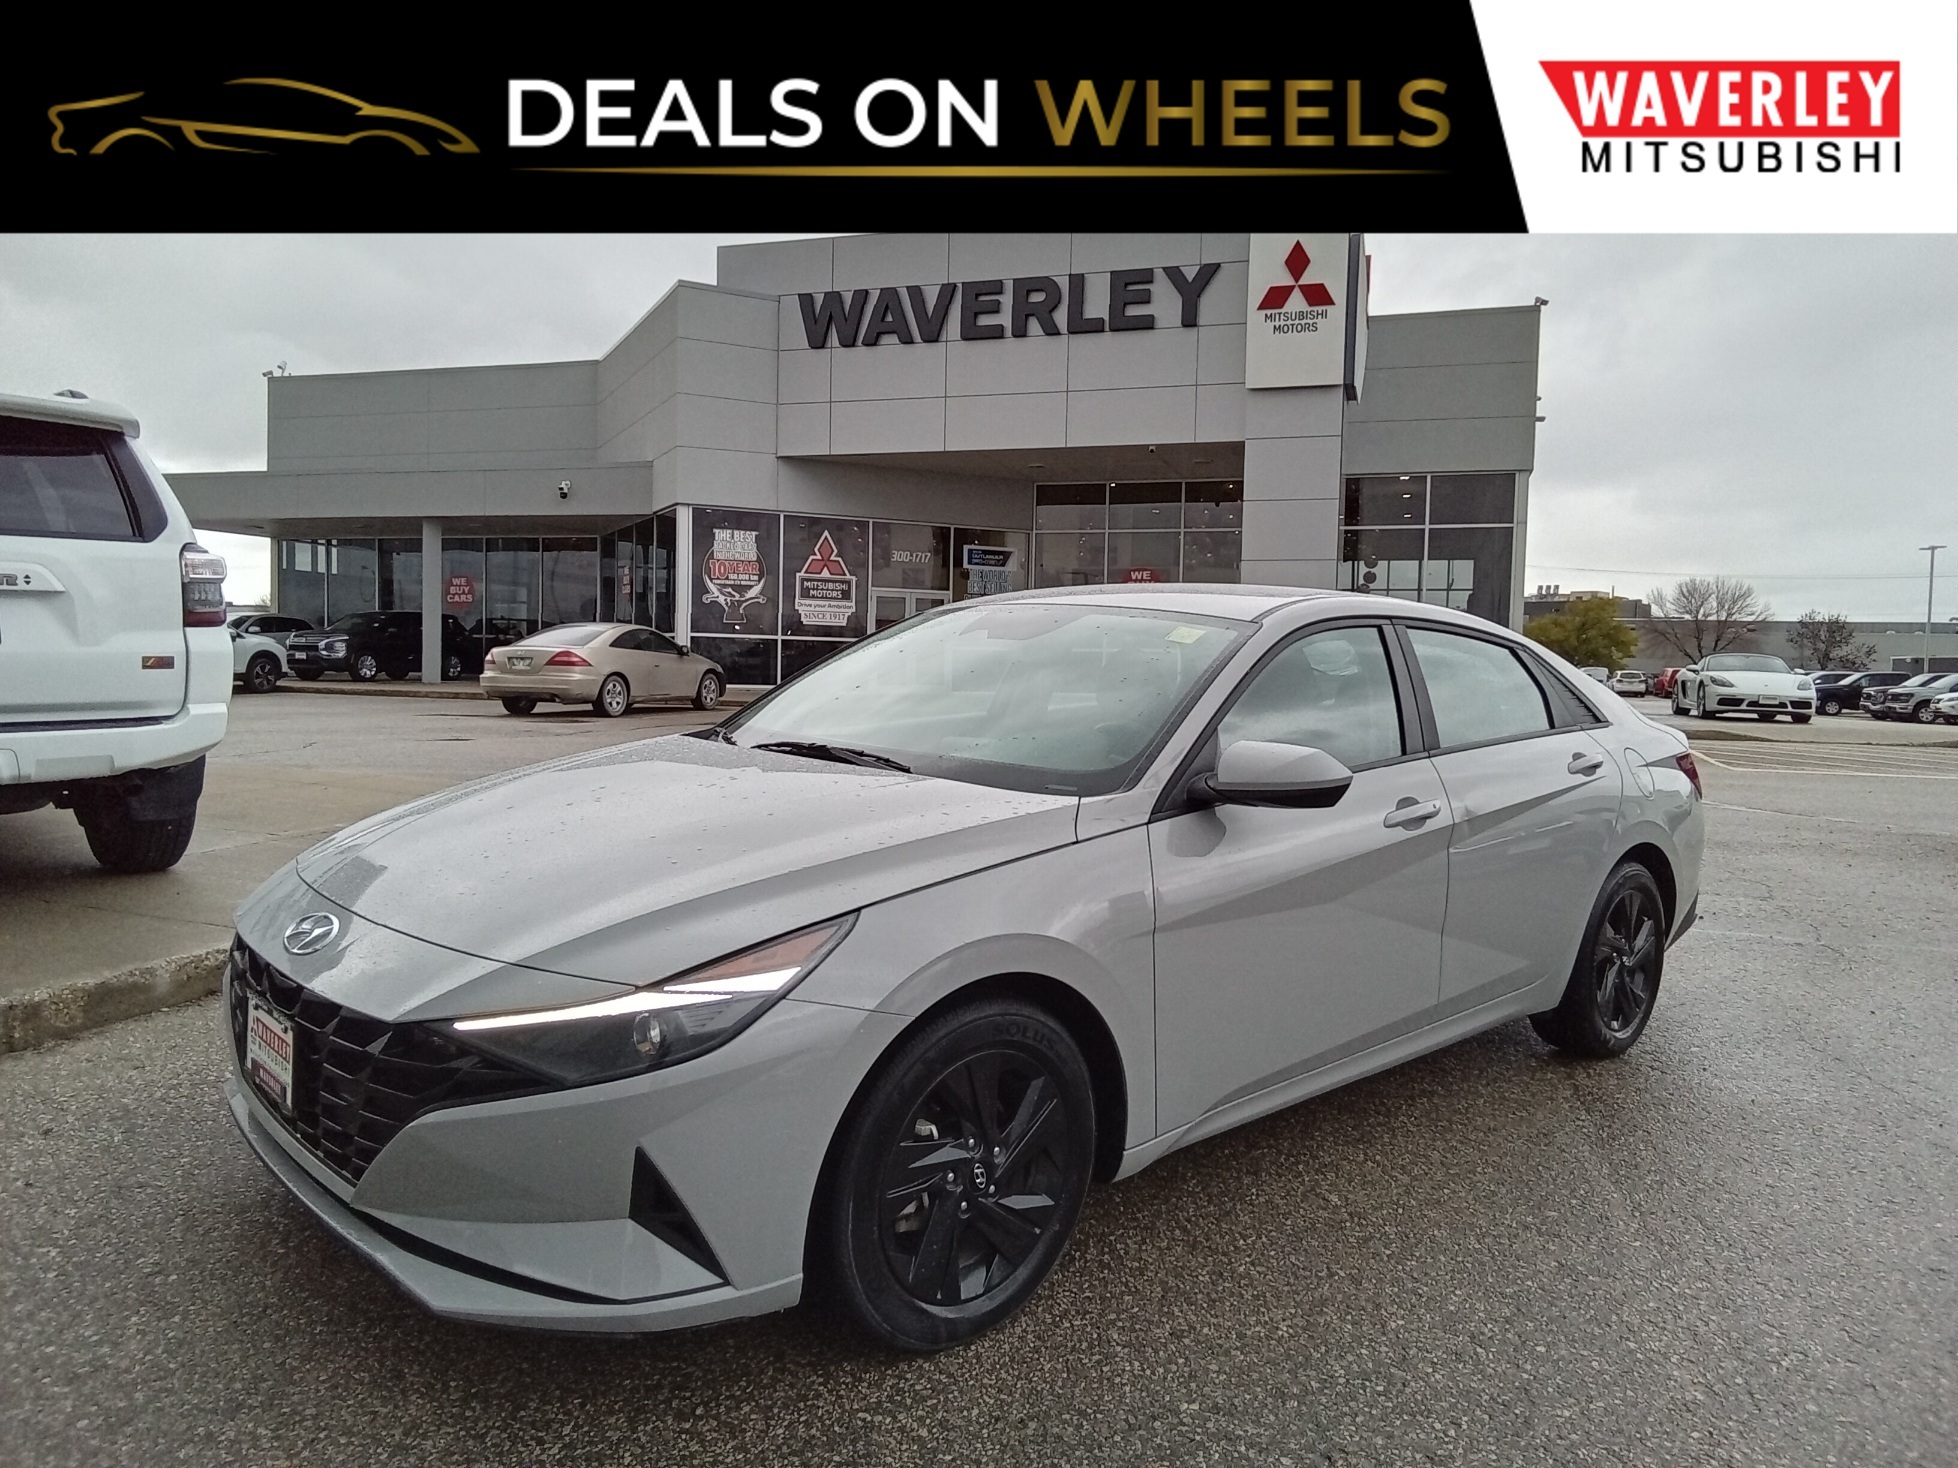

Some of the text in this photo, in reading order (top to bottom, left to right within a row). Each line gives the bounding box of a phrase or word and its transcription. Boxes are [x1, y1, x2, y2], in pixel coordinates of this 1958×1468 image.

[798, 263, 1221, 349] WAVERLEY
[1264, 308, 1328, 324] MITSUBISHI
[1272, 321, 1319, 336] MOTORS
[713, 528, 759, 542] THE BEST
[891, 550, 932, 563] 300-1717
[709, 560, 759, 579] 10 YEAR
[1130, 570, 1152, 580] WE
[451, 577, 468, 586] WE
[803, 581, 848, 590] MITSUBISHI
[450, 585, 470, 594] BUY
[809, 590, 842, 598] MOTORS
[447, 594, 473, 603] CARS
[827, 602, 854, 610] Ambition
[803, 612, 846, 621] SINCE 1917
[991, 1022, 1058, 1052] SOLUS
